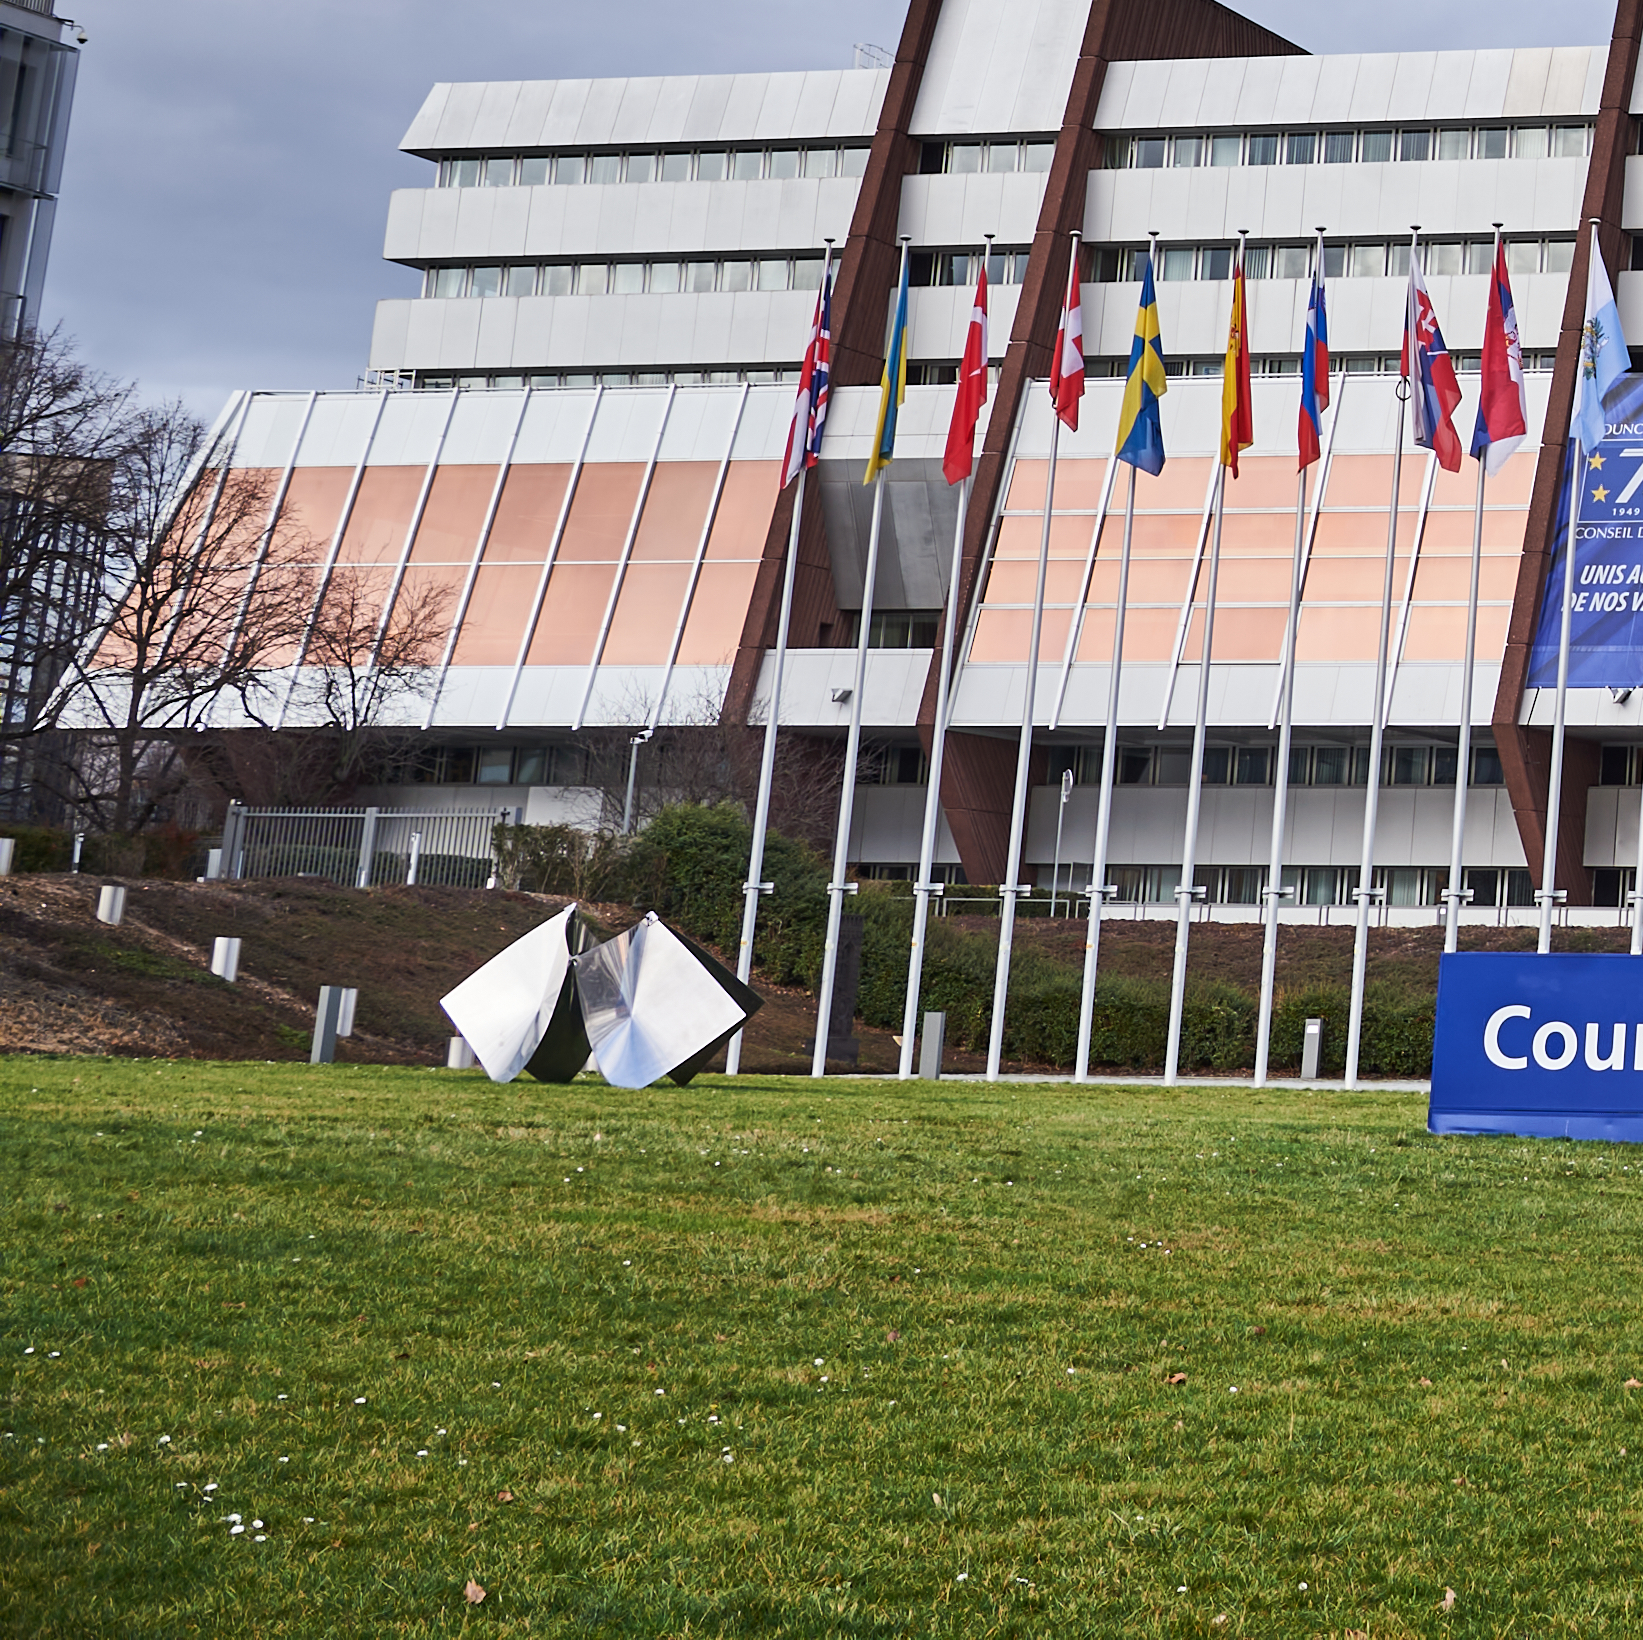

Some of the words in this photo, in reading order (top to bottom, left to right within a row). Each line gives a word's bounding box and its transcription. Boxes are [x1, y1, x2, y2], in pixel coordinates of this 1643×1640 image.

[1612, 508, 1641, 516] 1949
[1575, 526, 1633, 540] CONSEIL
[1580, 564, 1627, 585] UNIS
[1588, 591, 1631, 612] NOS
